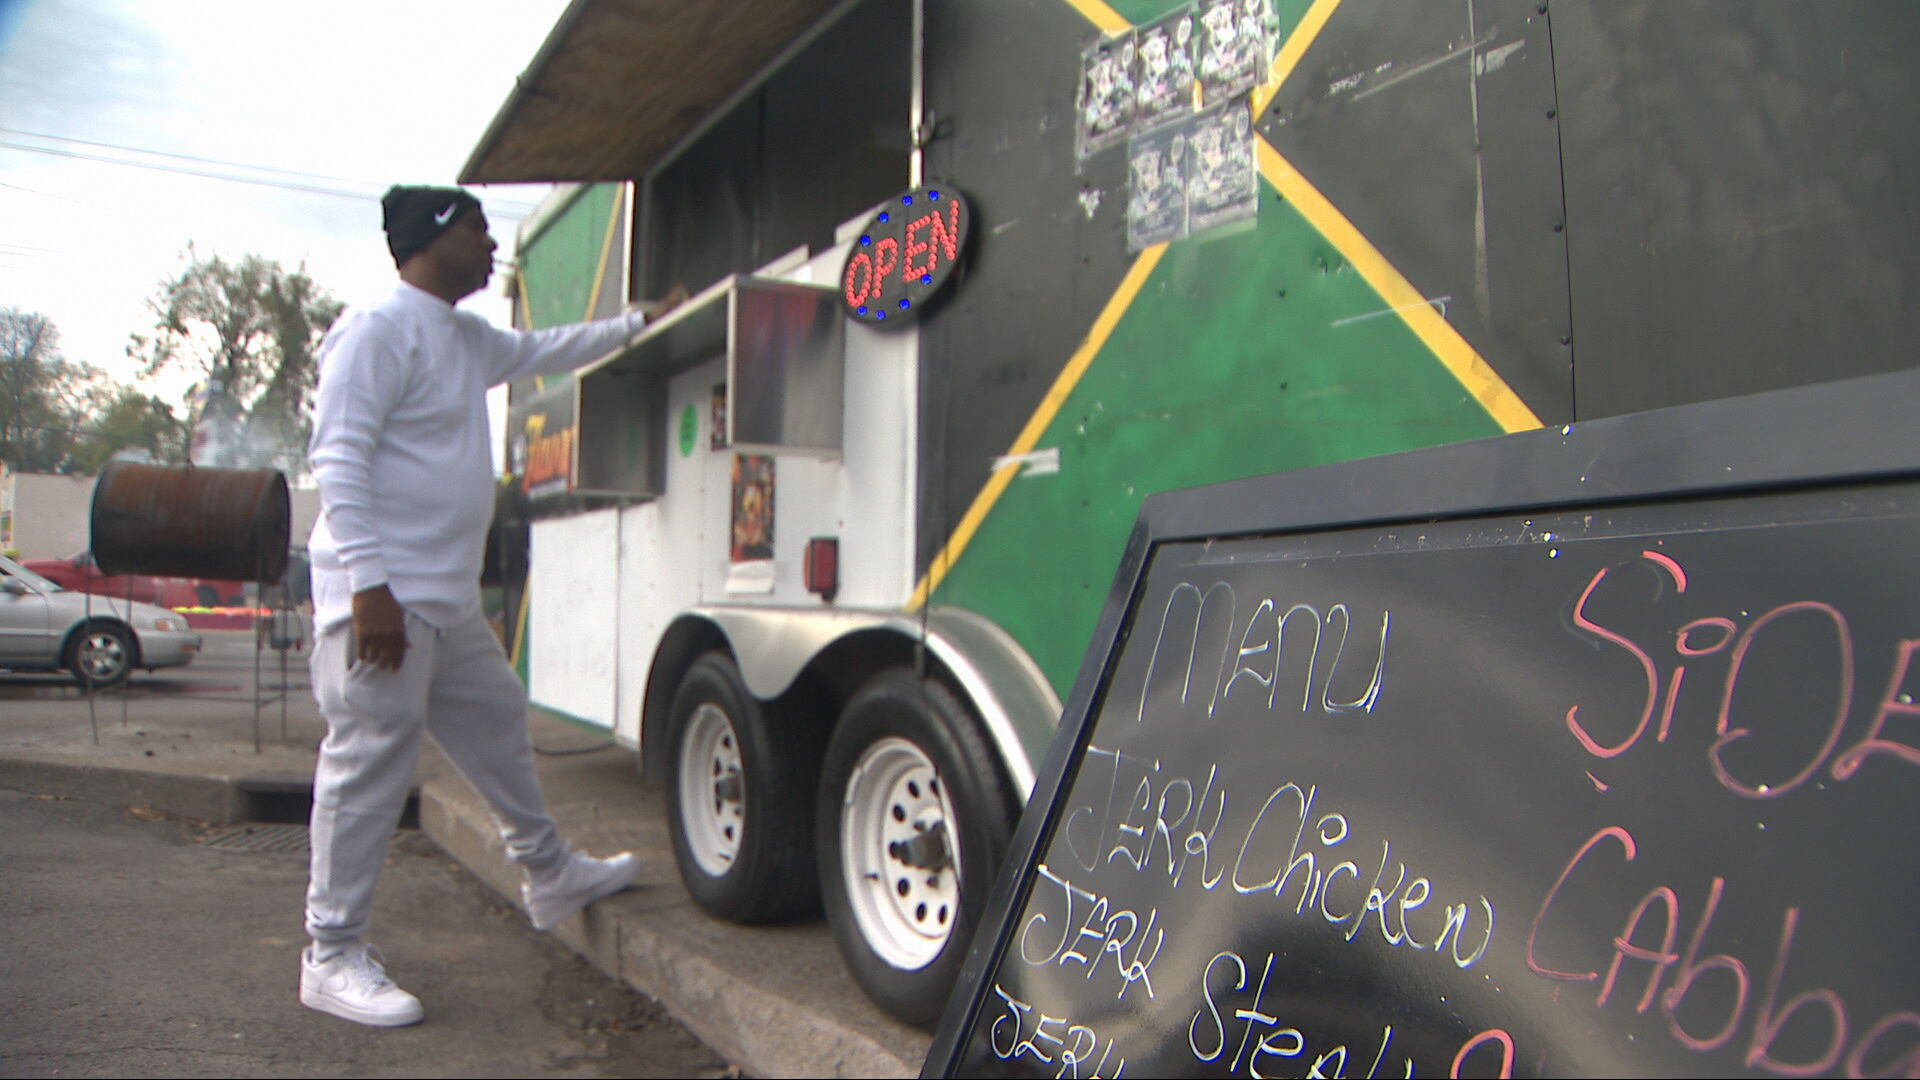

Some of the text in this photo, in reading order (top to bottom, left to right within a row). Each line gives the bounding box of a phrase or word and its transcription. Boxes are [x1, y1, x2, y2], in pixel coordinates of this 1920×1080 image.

[845, 200, 960, 307] OPEN
[1066, 745, 1226, 889] JERK
[1020, 864, 1165, 999] JERK
